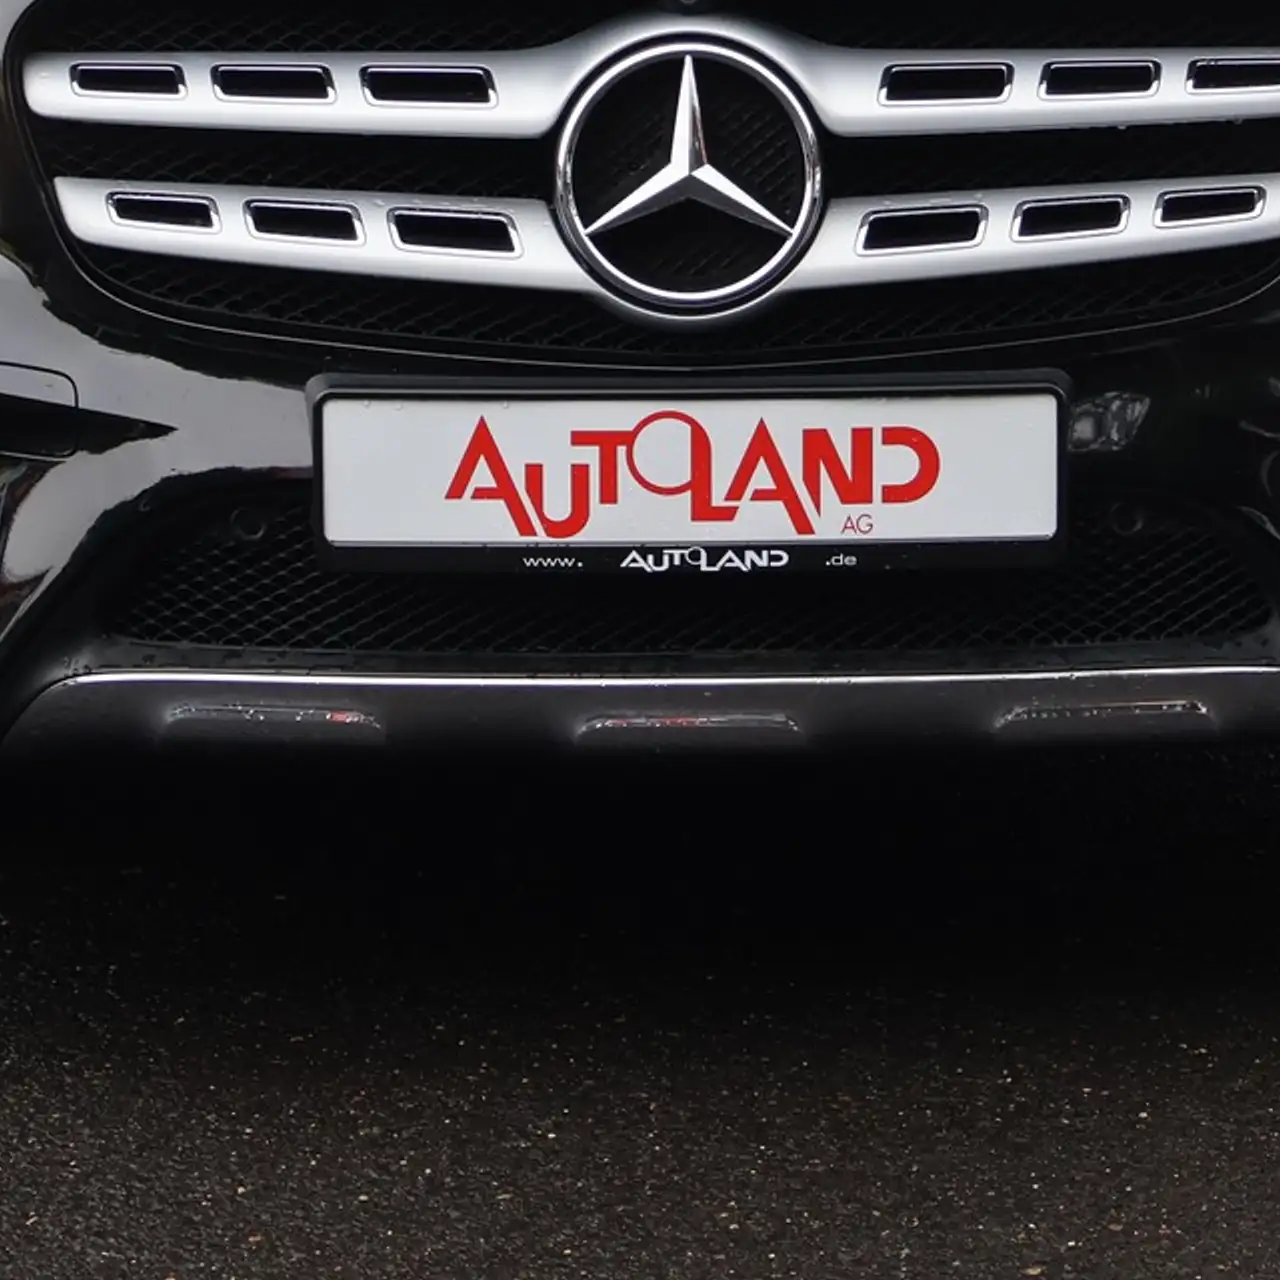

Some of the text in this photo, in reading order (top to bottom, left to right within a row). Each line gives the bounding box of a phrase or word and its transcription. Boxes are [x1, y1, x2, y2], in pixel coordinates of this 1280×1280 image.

[445, 410, 941, 539] AUTOLAND
[841, 514, 874, 535] AG
[522, 546, 857, 573] www. AUTOLAND .de
